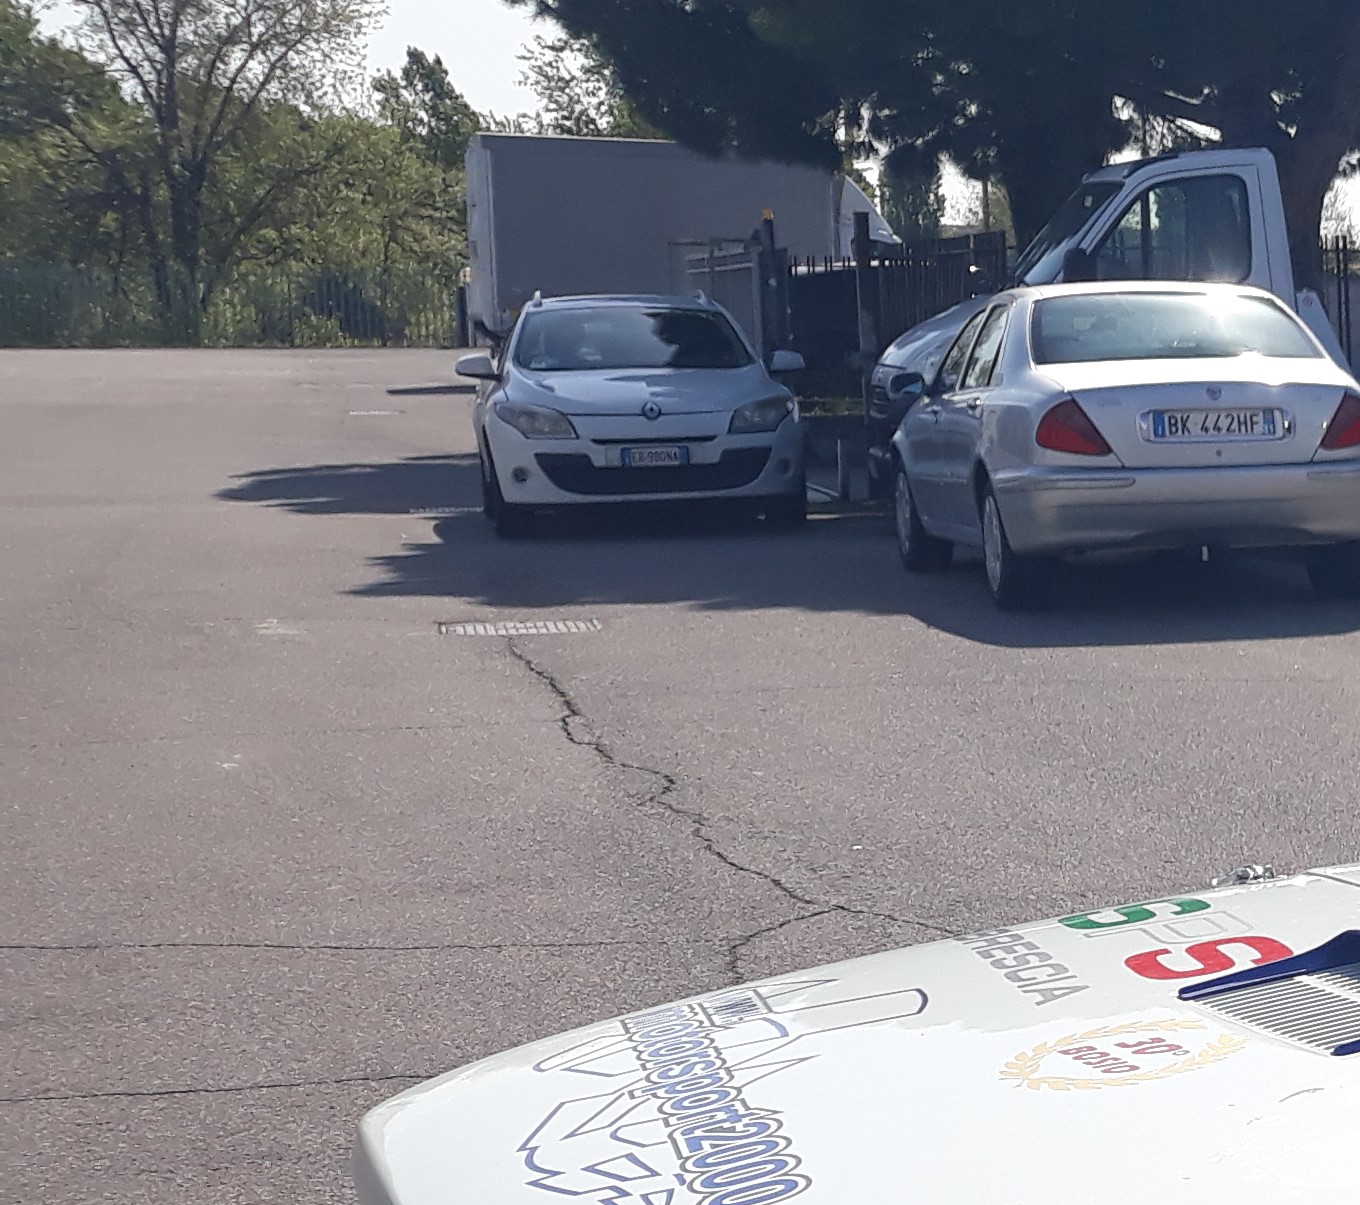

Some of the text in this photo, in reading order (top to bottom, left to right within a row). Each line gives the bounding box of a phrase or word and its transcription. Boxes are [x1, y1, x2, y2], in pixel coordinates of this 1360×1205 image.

[1167, 413, 1261, 436] BK 442HF
[954, 928, 1090, 1006] BRESCIA
[1061, 1045, 1141, 1074] BOSIO
